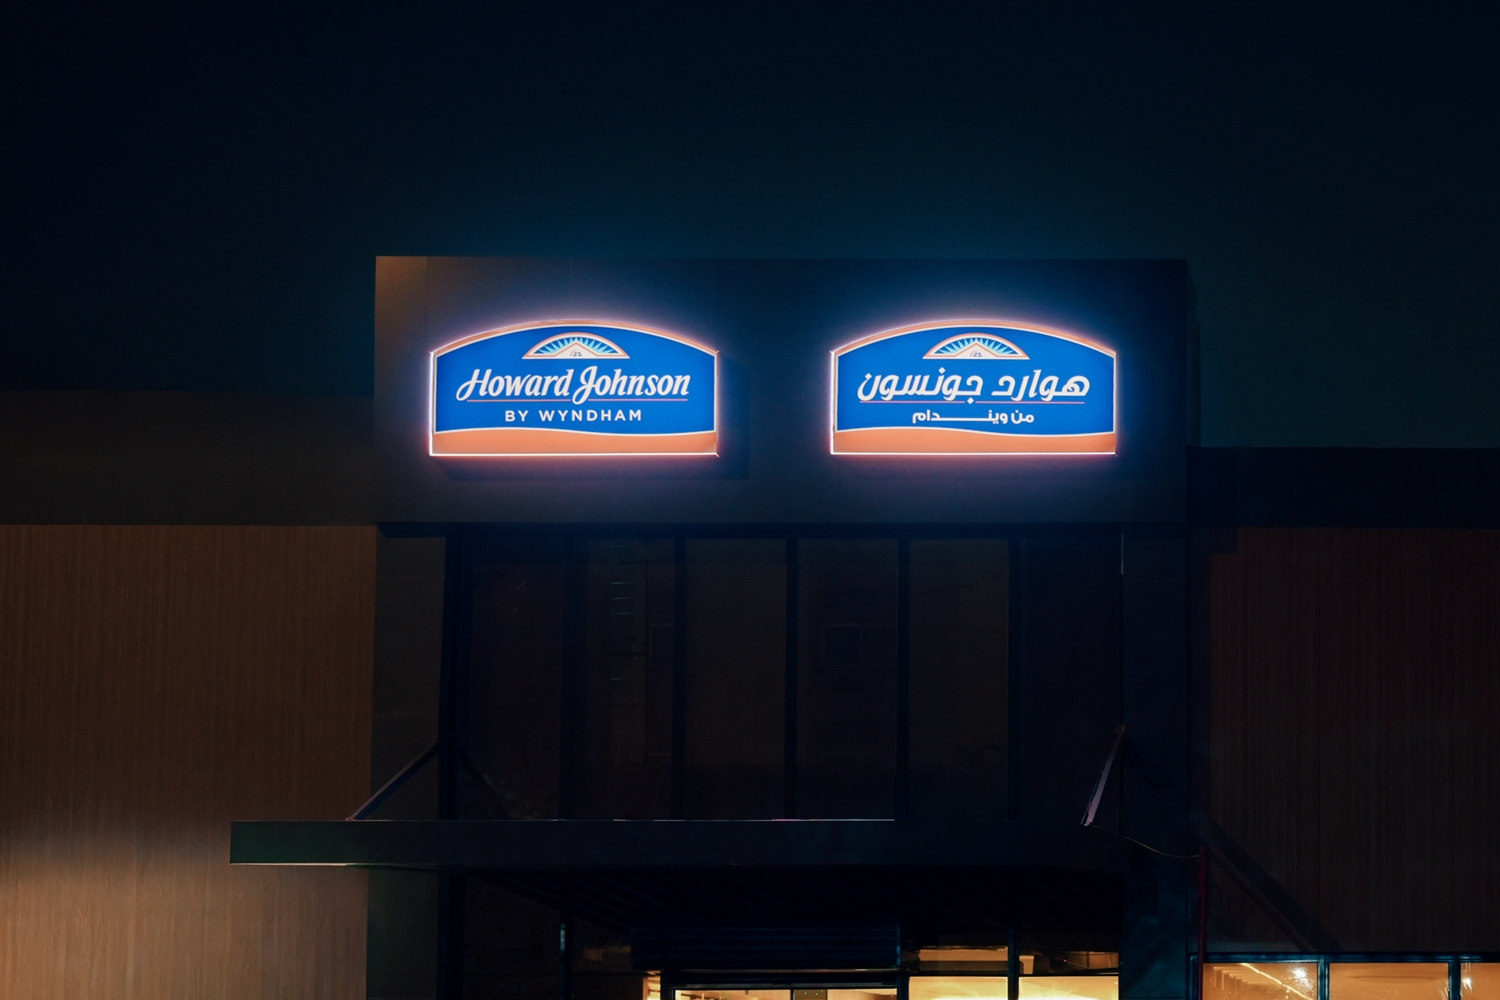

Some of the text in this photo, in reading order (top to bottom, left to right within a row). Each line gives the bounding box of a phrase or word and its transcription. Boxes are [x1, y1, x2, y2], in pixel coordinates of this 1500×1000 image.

[456, 365, 691, 405] Howard Johnson
[857, 367, 1090, 404] هوارد جونسون
[505, 409, 642, 422] BY WYNDHAM
[1011, 409, 1035, 424] من
